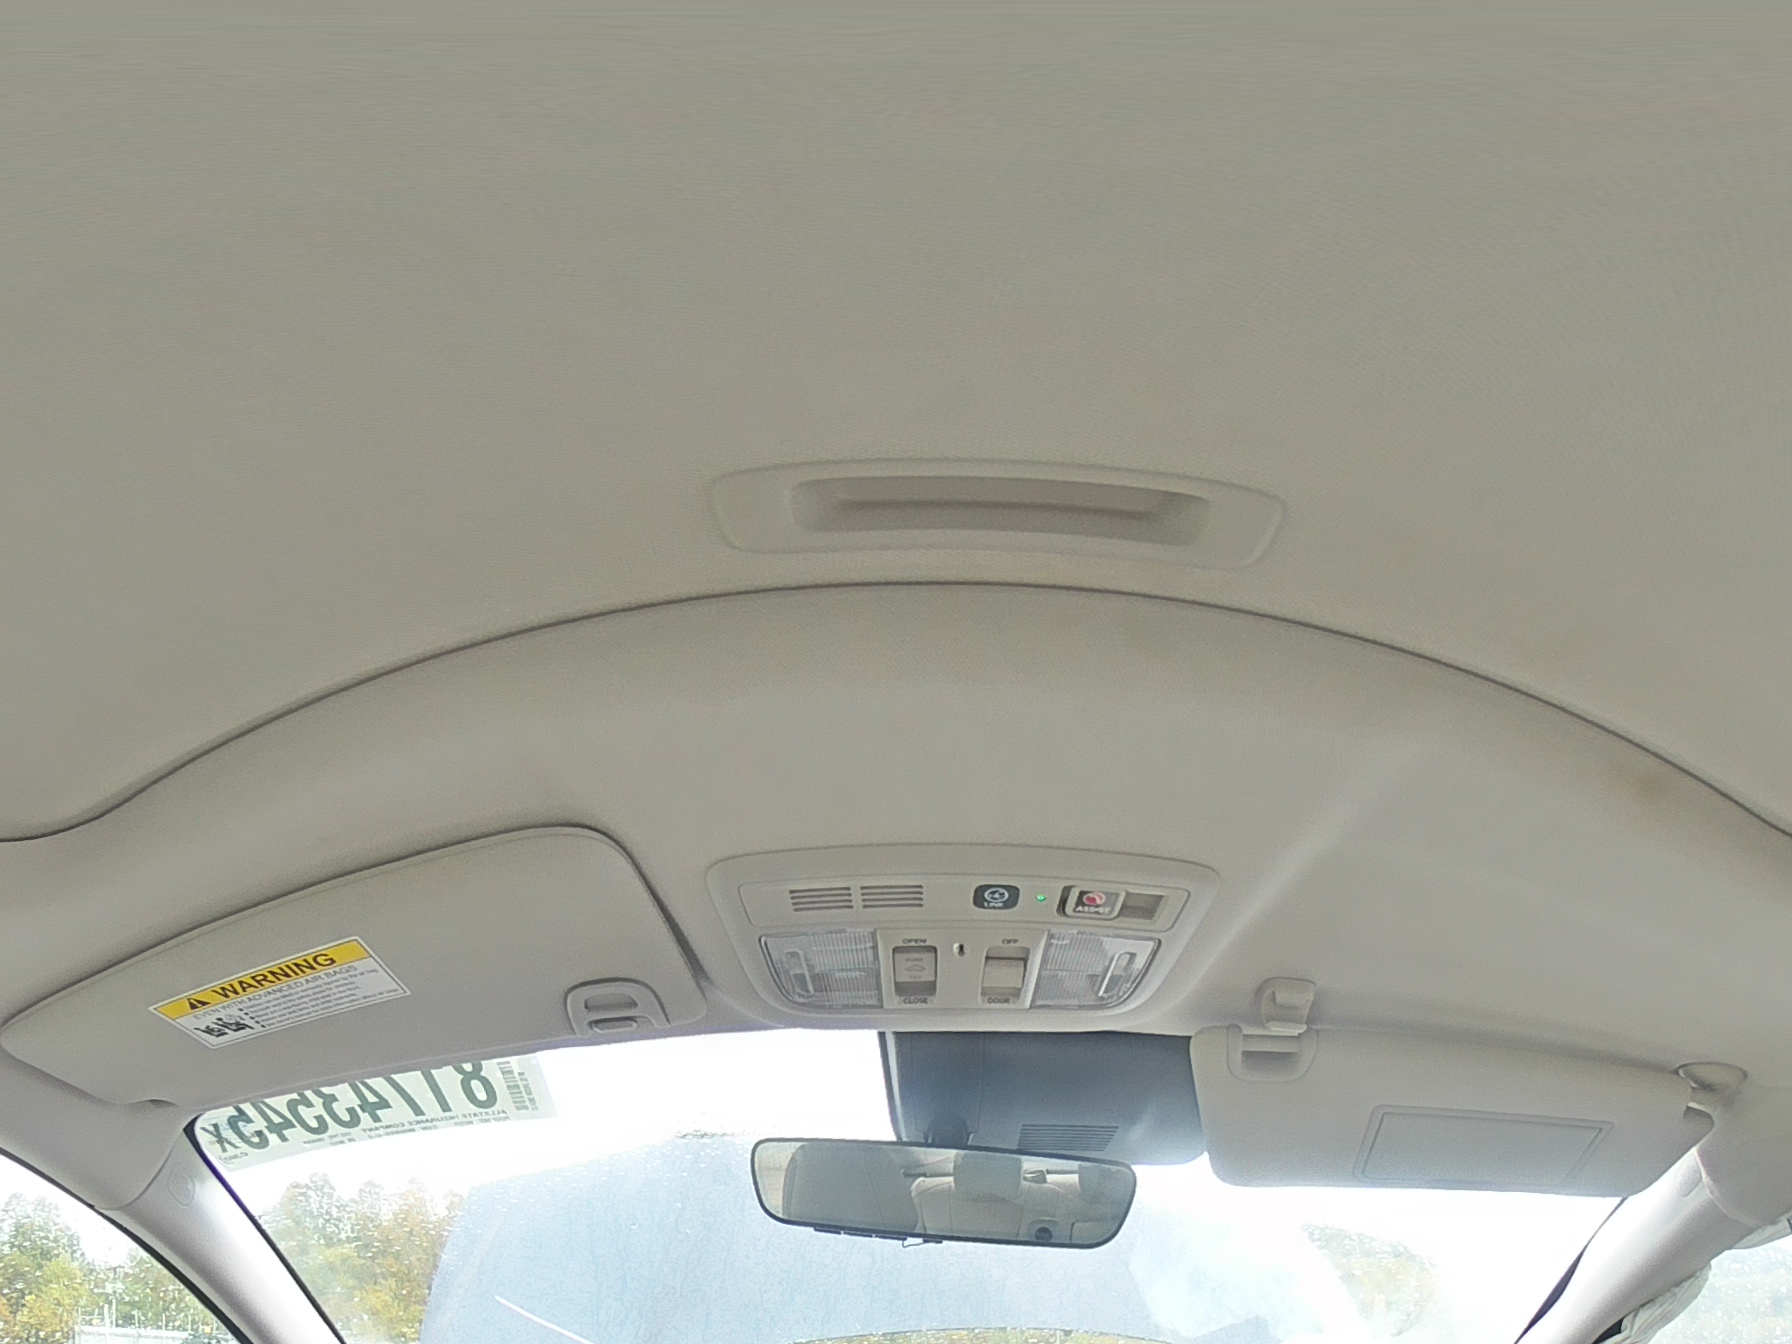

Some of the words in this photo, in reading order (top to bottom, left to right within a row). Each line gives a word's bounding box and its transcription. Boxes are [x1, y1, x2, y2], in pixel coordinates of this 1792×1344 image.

[211, 953, 337, 999] WARNING
[246, 980, 304, 1003] ADVANCED
[323, 965, 358, 979] BAGS
